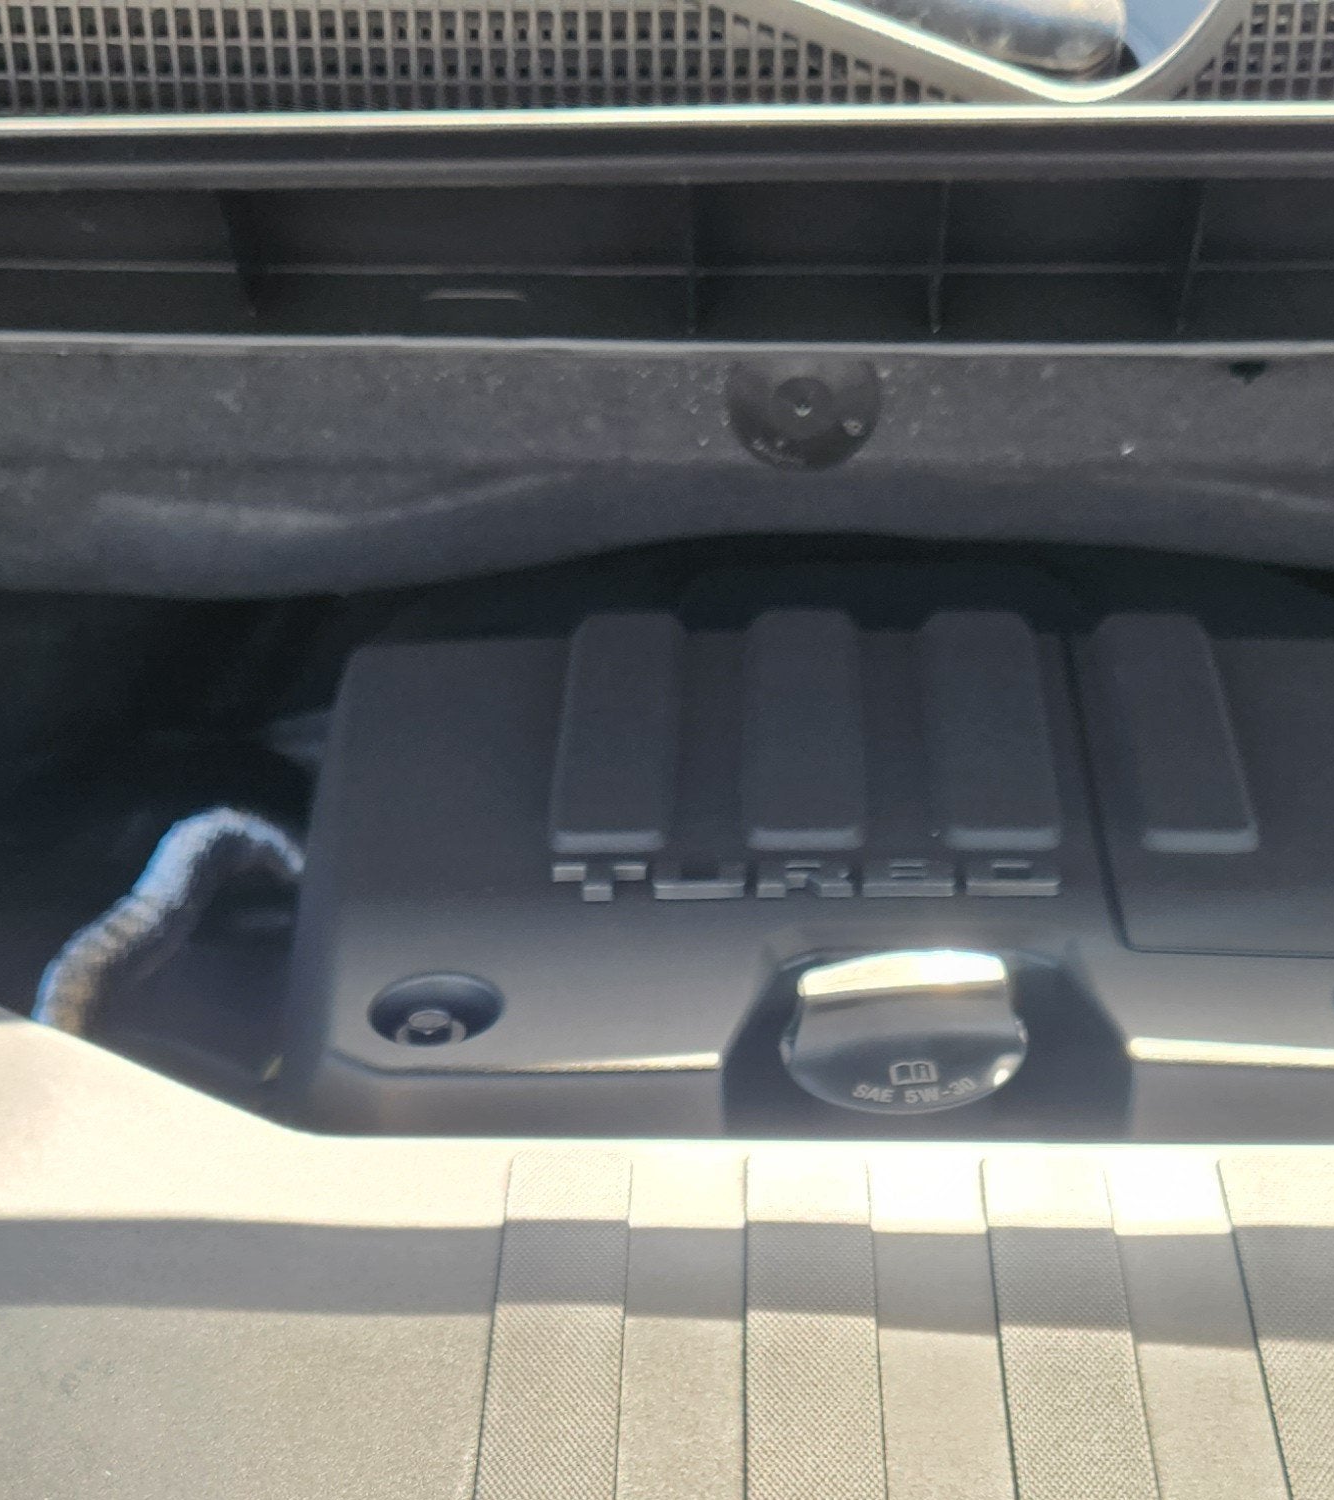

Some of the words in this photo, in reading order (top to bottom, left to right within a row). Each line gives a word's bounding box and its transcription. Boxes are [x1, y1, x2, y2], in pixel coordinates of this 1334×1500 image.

[551, 858, 1060, 902] TURBO
[852, 1083, 895, 1103] SAE
[904, 1077, 978, 1104] 5W-30
